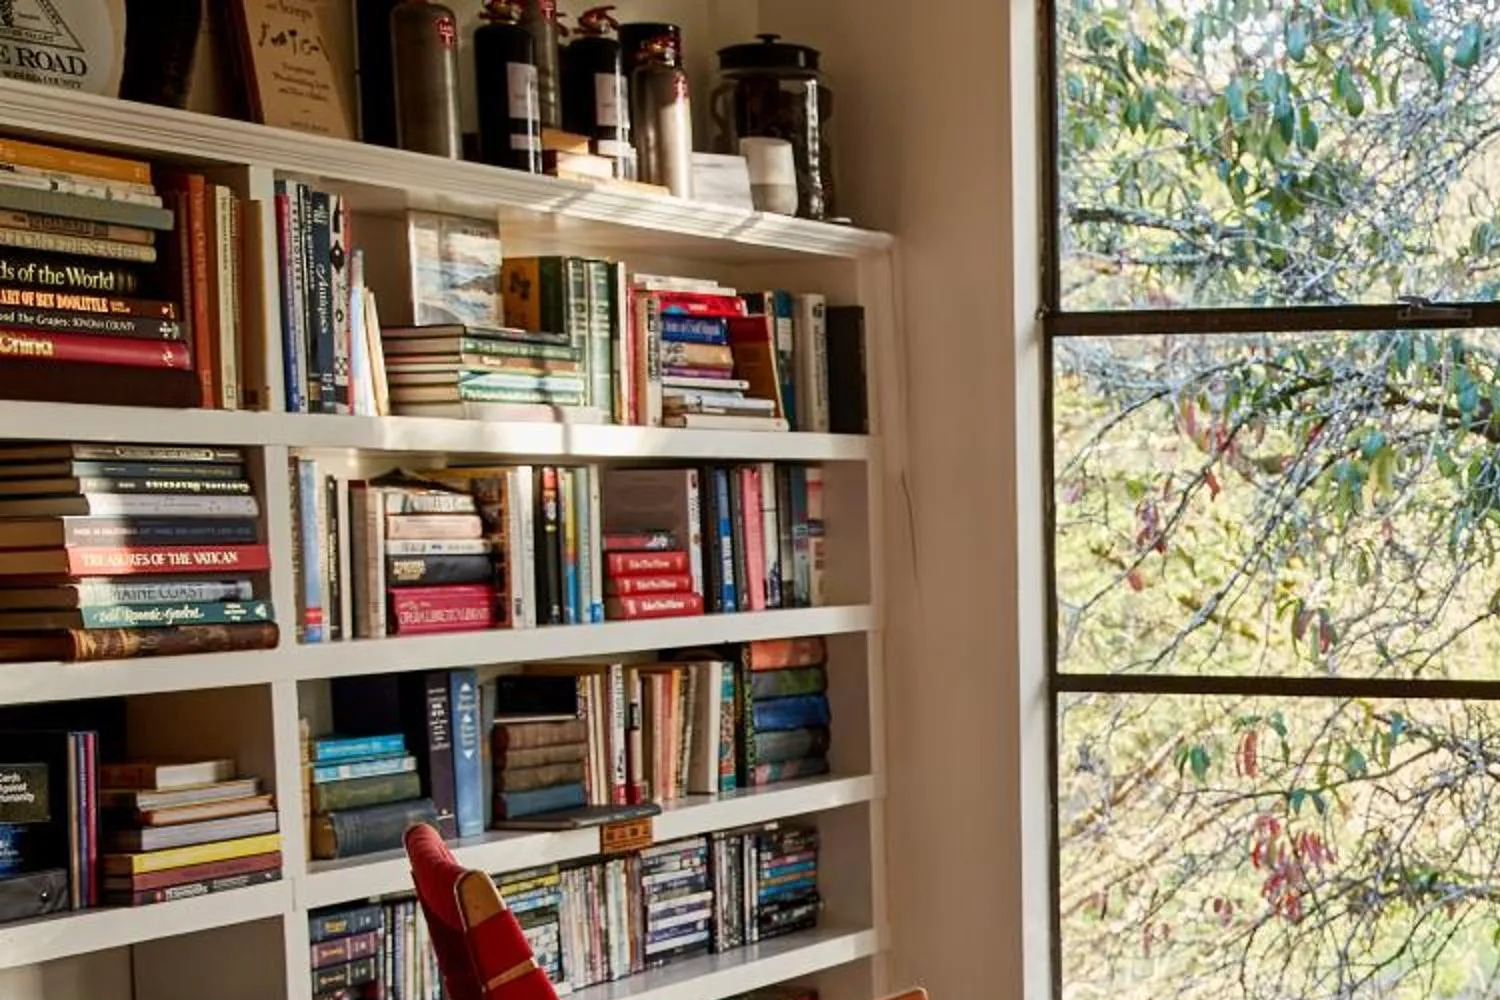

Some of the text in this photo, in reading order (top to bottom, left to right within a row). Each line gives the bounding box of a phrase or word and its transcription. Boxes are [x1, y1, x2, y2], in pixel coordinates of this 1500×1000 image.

[15, 47, 88, 77] ROAD
[18, 263, 37, 282] of
[38, 266, 65, 285] the
[65, 267, 115, 291] World
[21, 290, 35, 306] OF
[56, 294, 109, 313] DOOLITTLE
[0, 335, 54, 356] China
[151, 552, 166, 566] OF
[168, 552, 193, 566] THE
[193, 550, 239, 565] VATICAN
[158, 587, 204, 600] COAST
